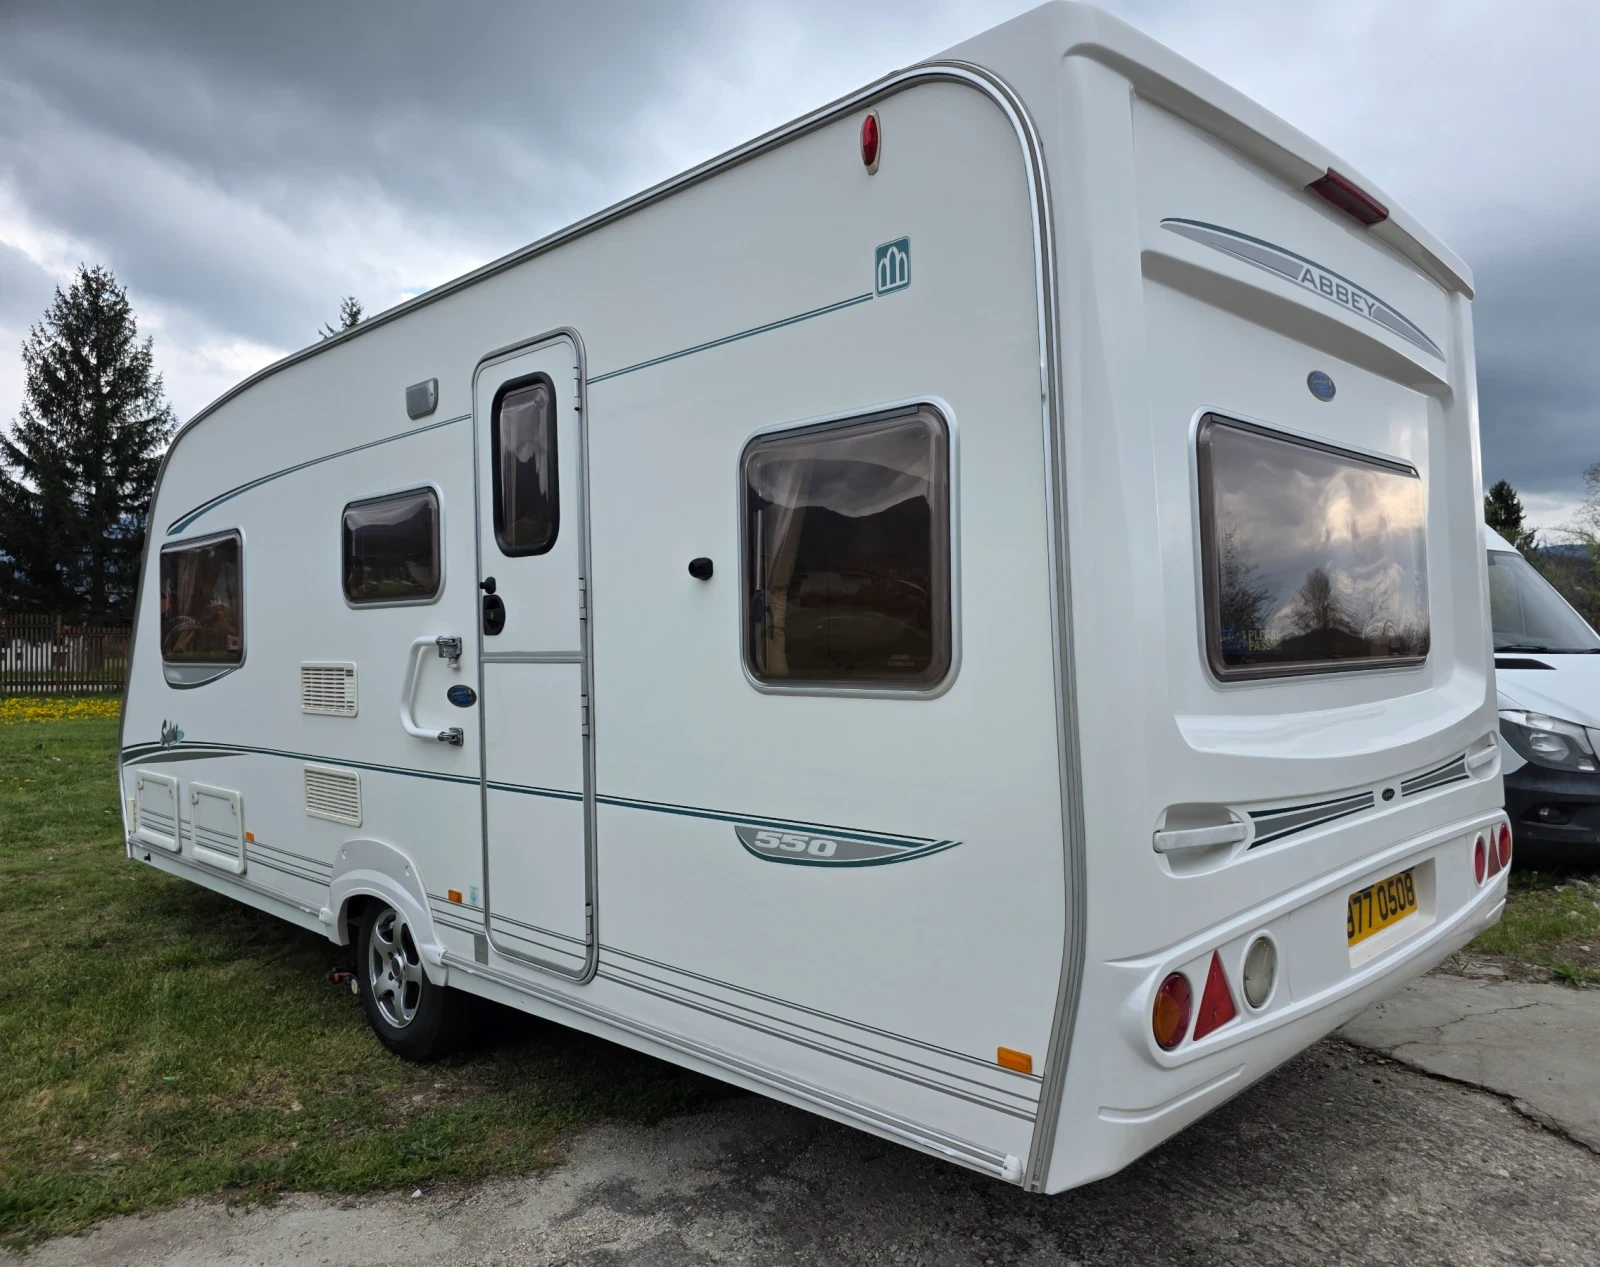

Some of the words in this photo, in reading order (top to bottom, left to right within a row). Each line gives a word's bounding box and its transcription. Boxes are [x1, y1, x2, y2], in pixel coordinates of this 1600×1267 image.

[1300, 267, 1376, 318] ABBEY
[1248, 629, 1281, 640] PLEASE
[1248, 641, 1272, 651] PASS
[754, 831, 838, 857] 550
[1376, 872, 1415, 921] 0508
